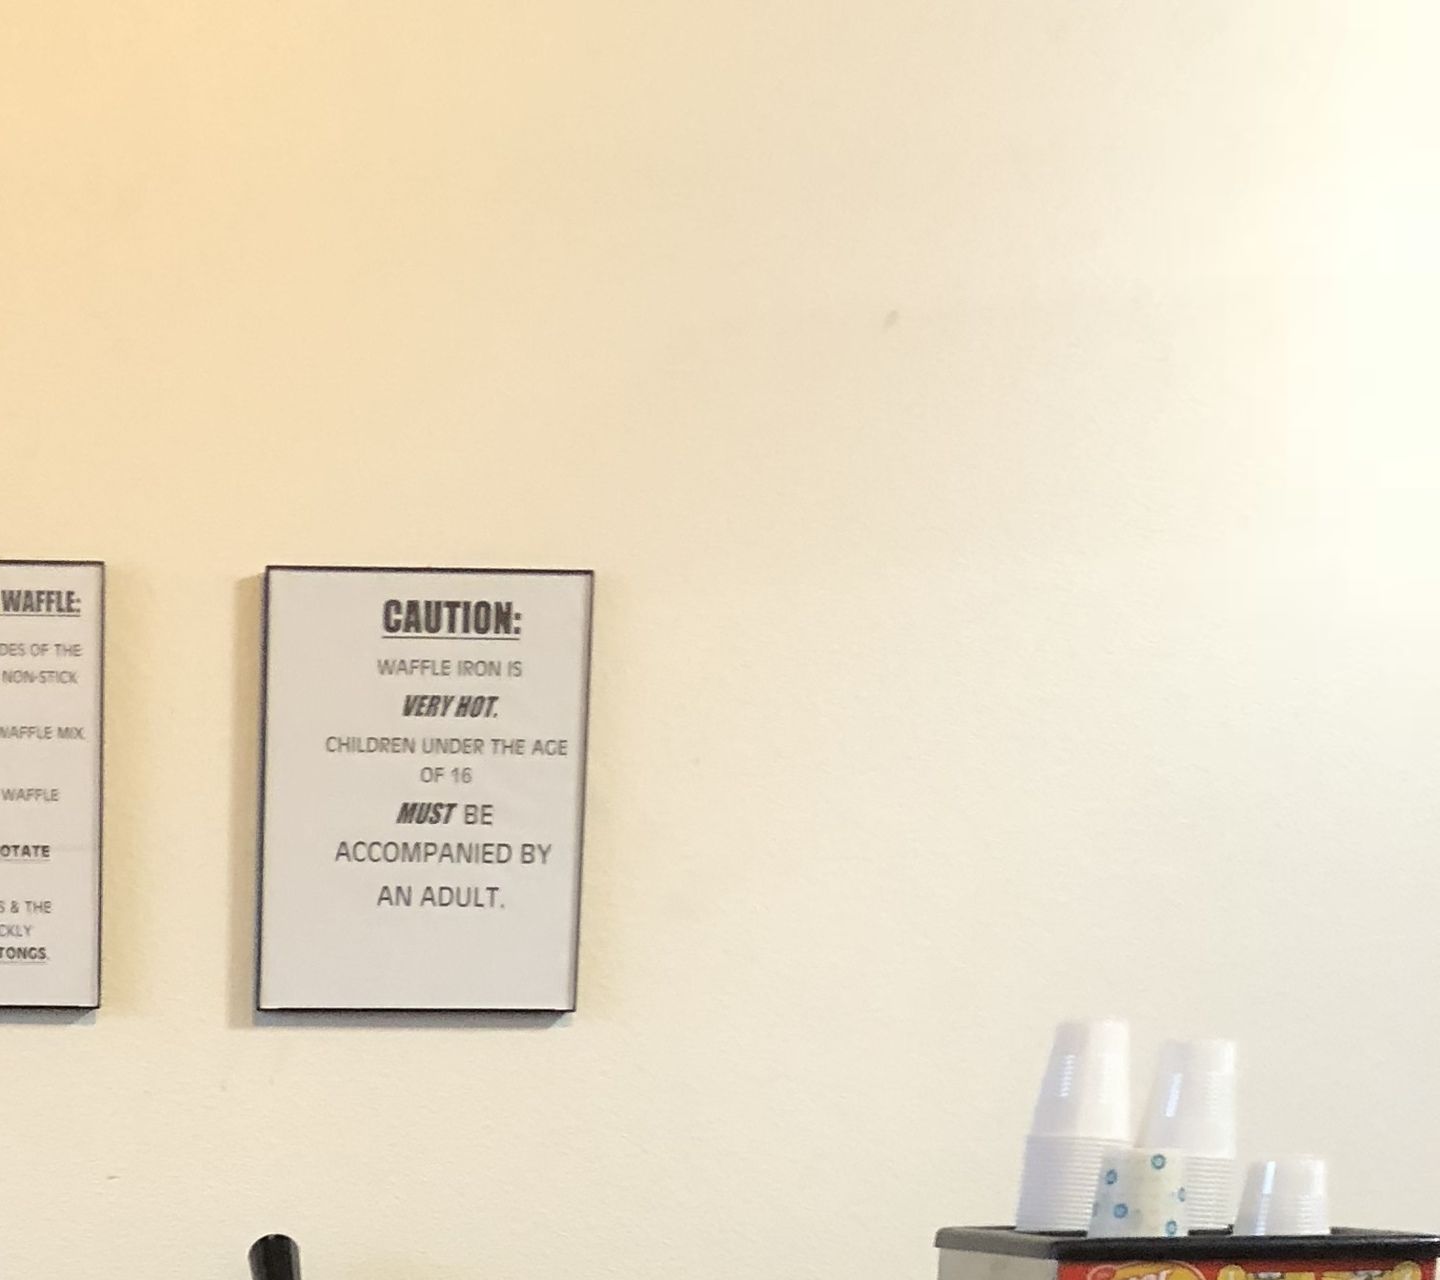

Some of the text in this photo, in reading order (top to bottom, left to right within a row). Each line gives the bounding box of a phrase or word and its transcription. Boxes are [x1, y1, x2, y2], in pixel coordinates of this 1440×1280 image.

[1, 589, 81, 613] WAFFLE:
[383, 599, 522, 635] CAUTION:
[30, 643, 49, 657] OF
[54, 643, 82, 657] THE
[2, 669, 79, 684] NON-STICK
[377, 659, 522, 677] WAFFLE IRON IS
[402, 695, 499, 718] VERY HOT.
[326, 736, 568, 756] CHILDREN UNDER THE AGE
[420, 766, 472, 783] OF 16
[1, 788, 59, 801] WAFFLE
[396, 802, 494, 825] MUST BE
[335, 841, 551, 864] ACCOMPANIED BY
[377, 885, 505, 908] AN ADULT.
[10, 900, 19, 914] &
[25, 901, 52, 914] THE
